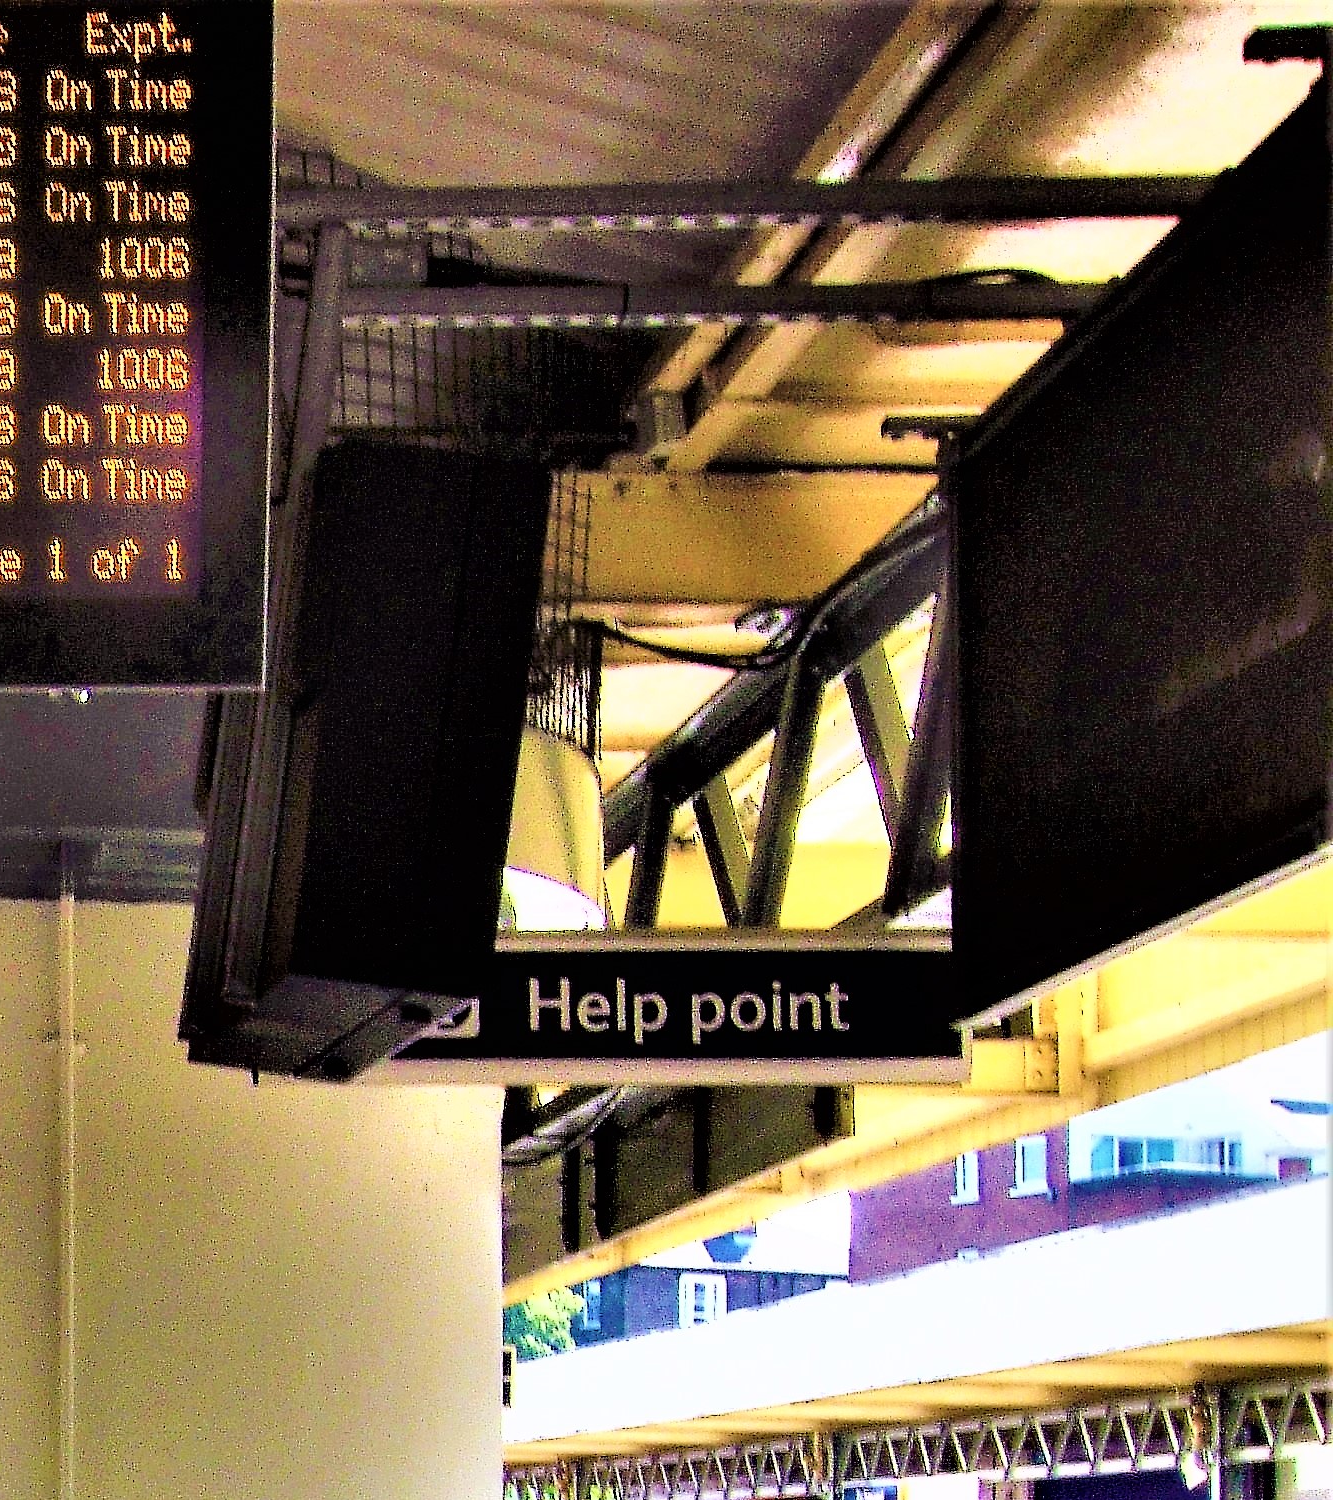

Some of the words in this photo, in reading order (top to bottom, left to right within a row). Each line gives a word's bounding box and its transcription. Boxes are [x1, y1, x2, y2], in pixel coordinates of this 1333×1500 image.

[87, 12, 191, 62] Expt.
[45, 69, 92, 110] On
[105, 69, 190, 110] Time
[45, 126, 91, 166] On
[105, 125, 191, 166] Time
[44, 181, 91, 222] On
[104, 180, 190, 222] Time
[99, 237, 190, 280] 1006
[44, 293, 90, 334] On
[102, 292, 189, 334] Time
[98, 347, 189, 390] 1006
[43, 404, 90, 445] On
[101, 403, 188, 445] Time
[42, 459, 90, 501] On
[101, 458, 187, 501] Time
[47, 537, 64, 581] 1
[92, 537, 138, 581] of
[166, 538, 182, 581] 1
[529, 976, 668, 1045] Help
[691, 980, 850, 1045] point
